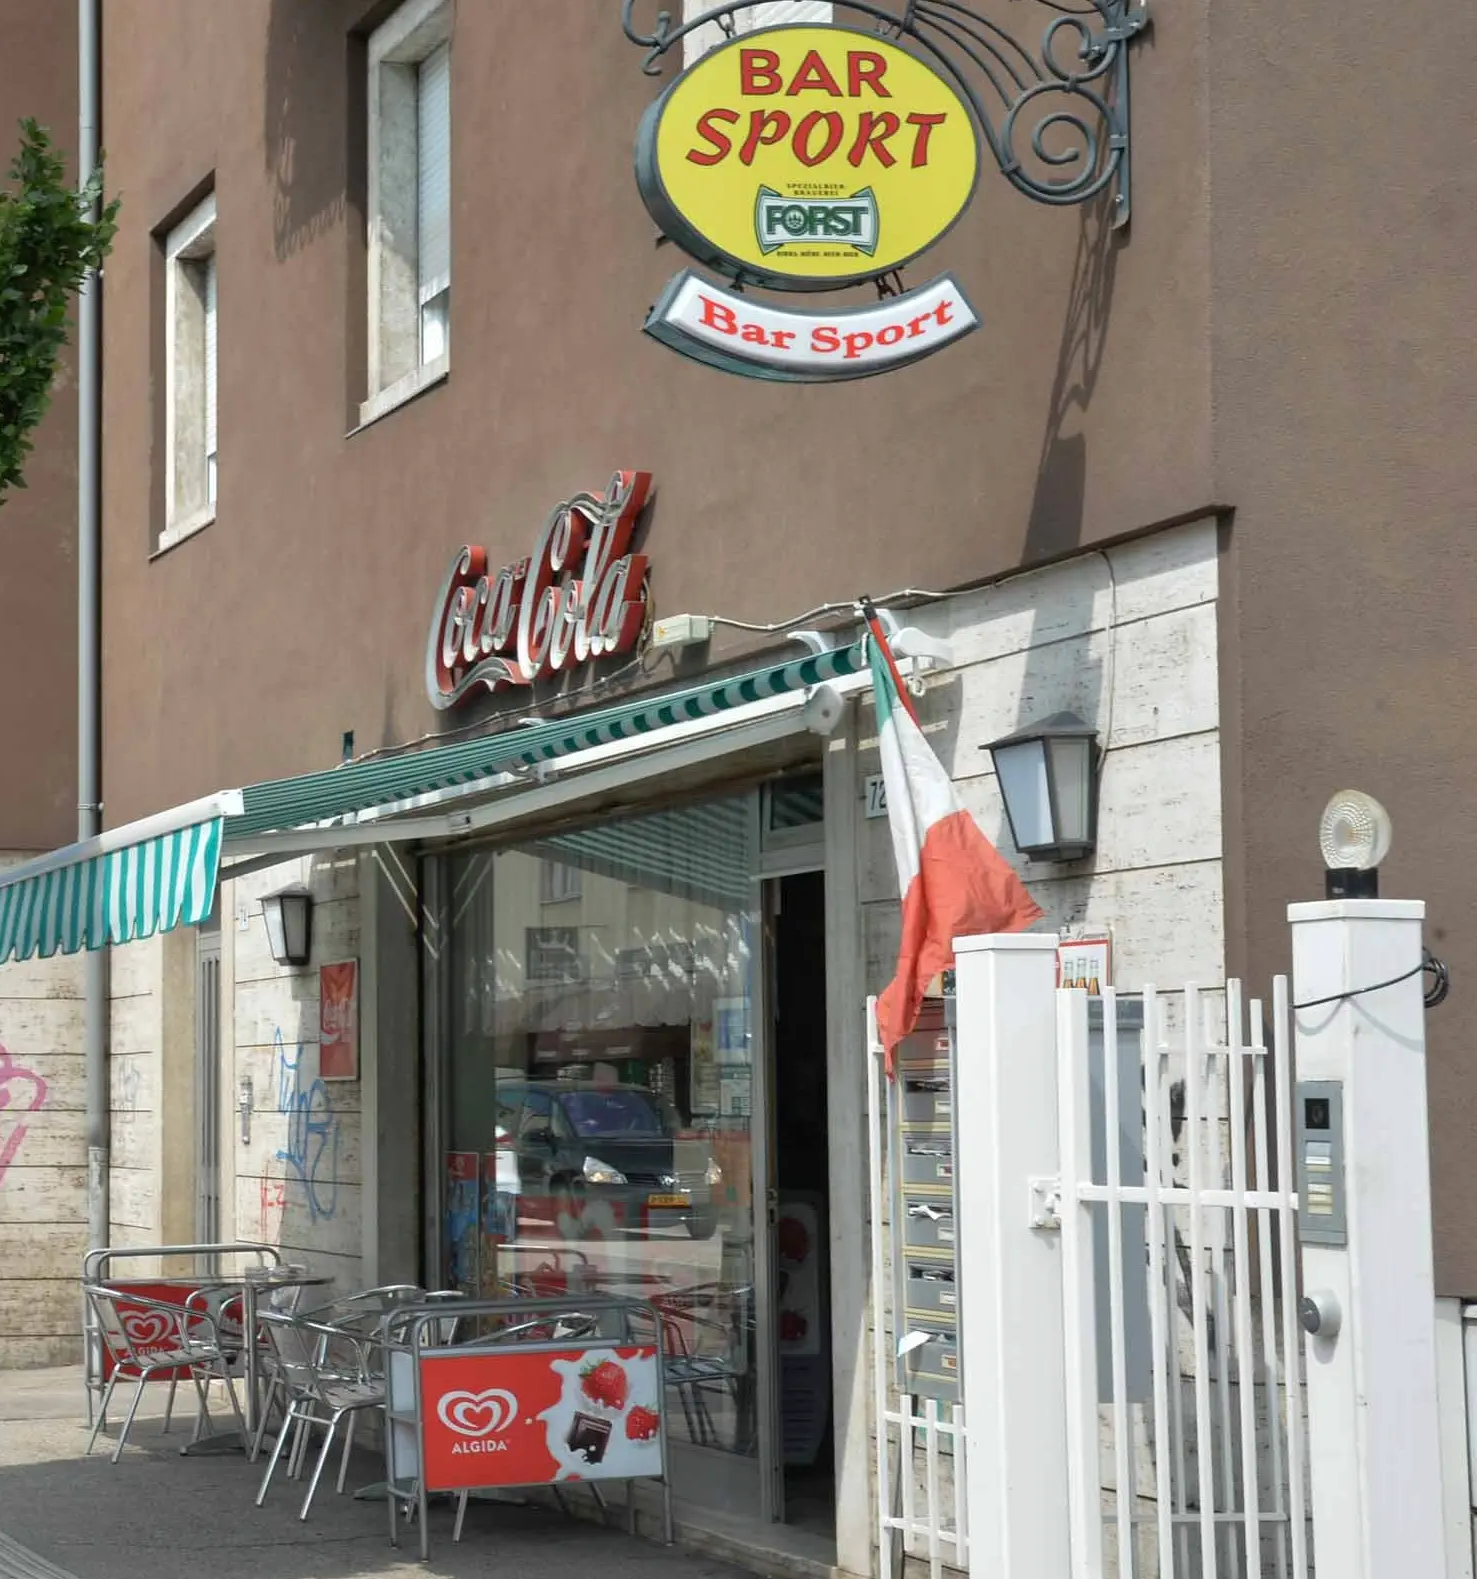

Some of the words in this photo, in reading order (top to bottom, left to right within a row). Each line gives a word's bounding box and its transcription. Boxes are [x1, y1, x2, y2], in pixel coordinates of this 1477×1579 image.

[739, 48, 893, 98] BAR
[685, 108, 947, 169] SPORT
[765, 204, 869, 237] FORST
[699, 295, 796, 349] Bar
[810, 299, 954, 358] Sport
[869, 780, 887, 811] 72
[451, 1439, 508, 1455] ALGIDA
